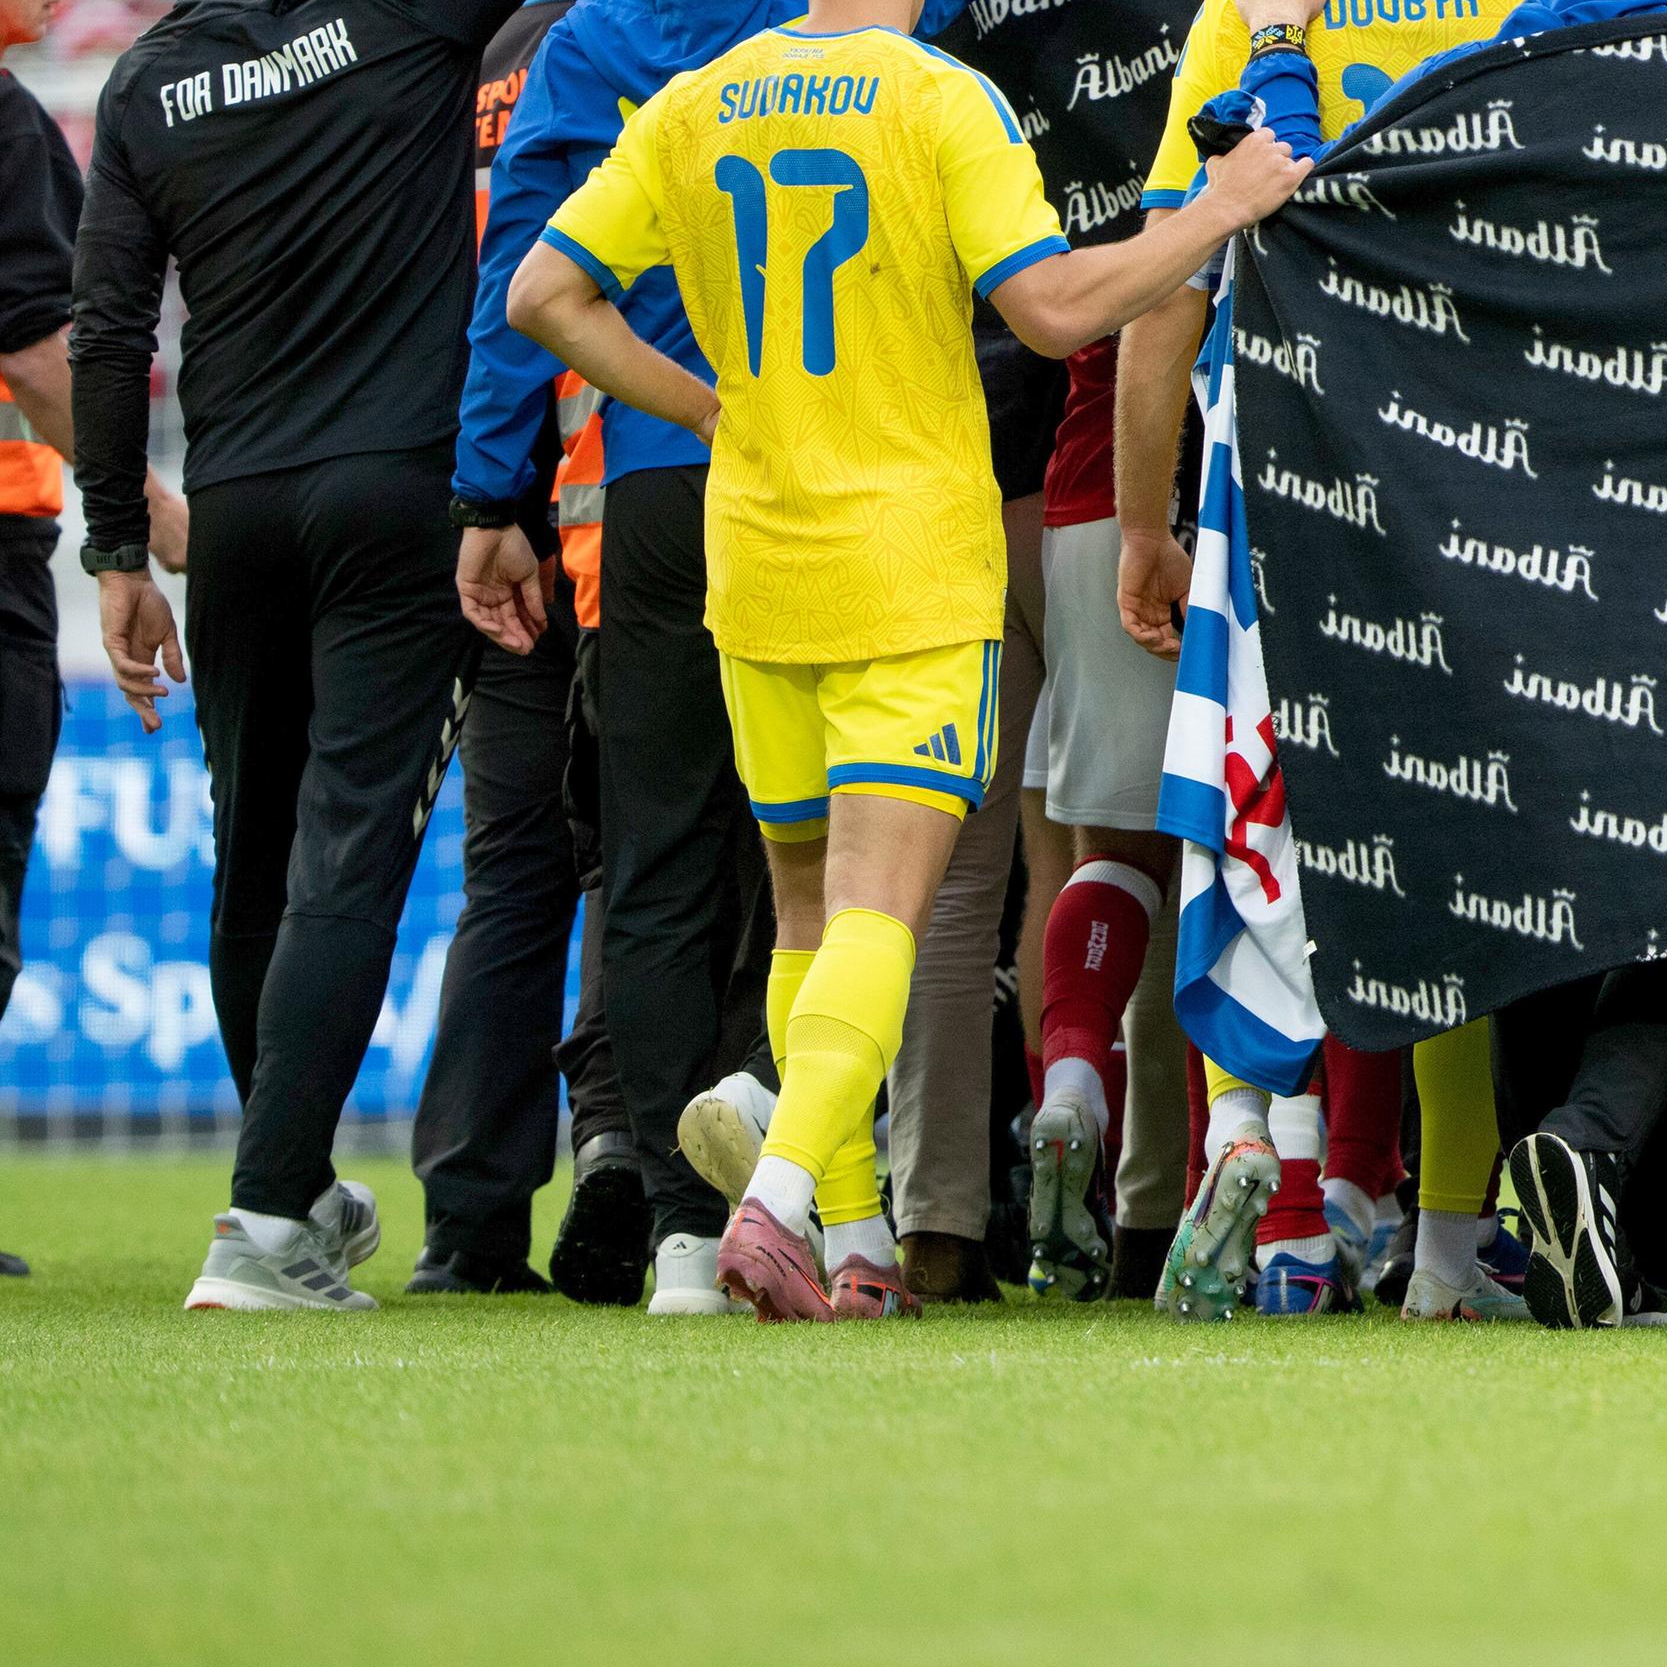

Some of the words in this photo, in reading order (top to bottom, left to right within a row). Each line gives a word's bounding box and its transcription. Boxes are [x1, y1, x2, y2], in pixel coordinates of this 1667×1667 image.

[160, 71, 212, 127] FOR
[222, 18, 358, 106] DANMARK
[718, 73, 880, 124] SUDAKOV
[1067, 22, 1180, 111] Albani
[715, 148, 869, 379] 17
